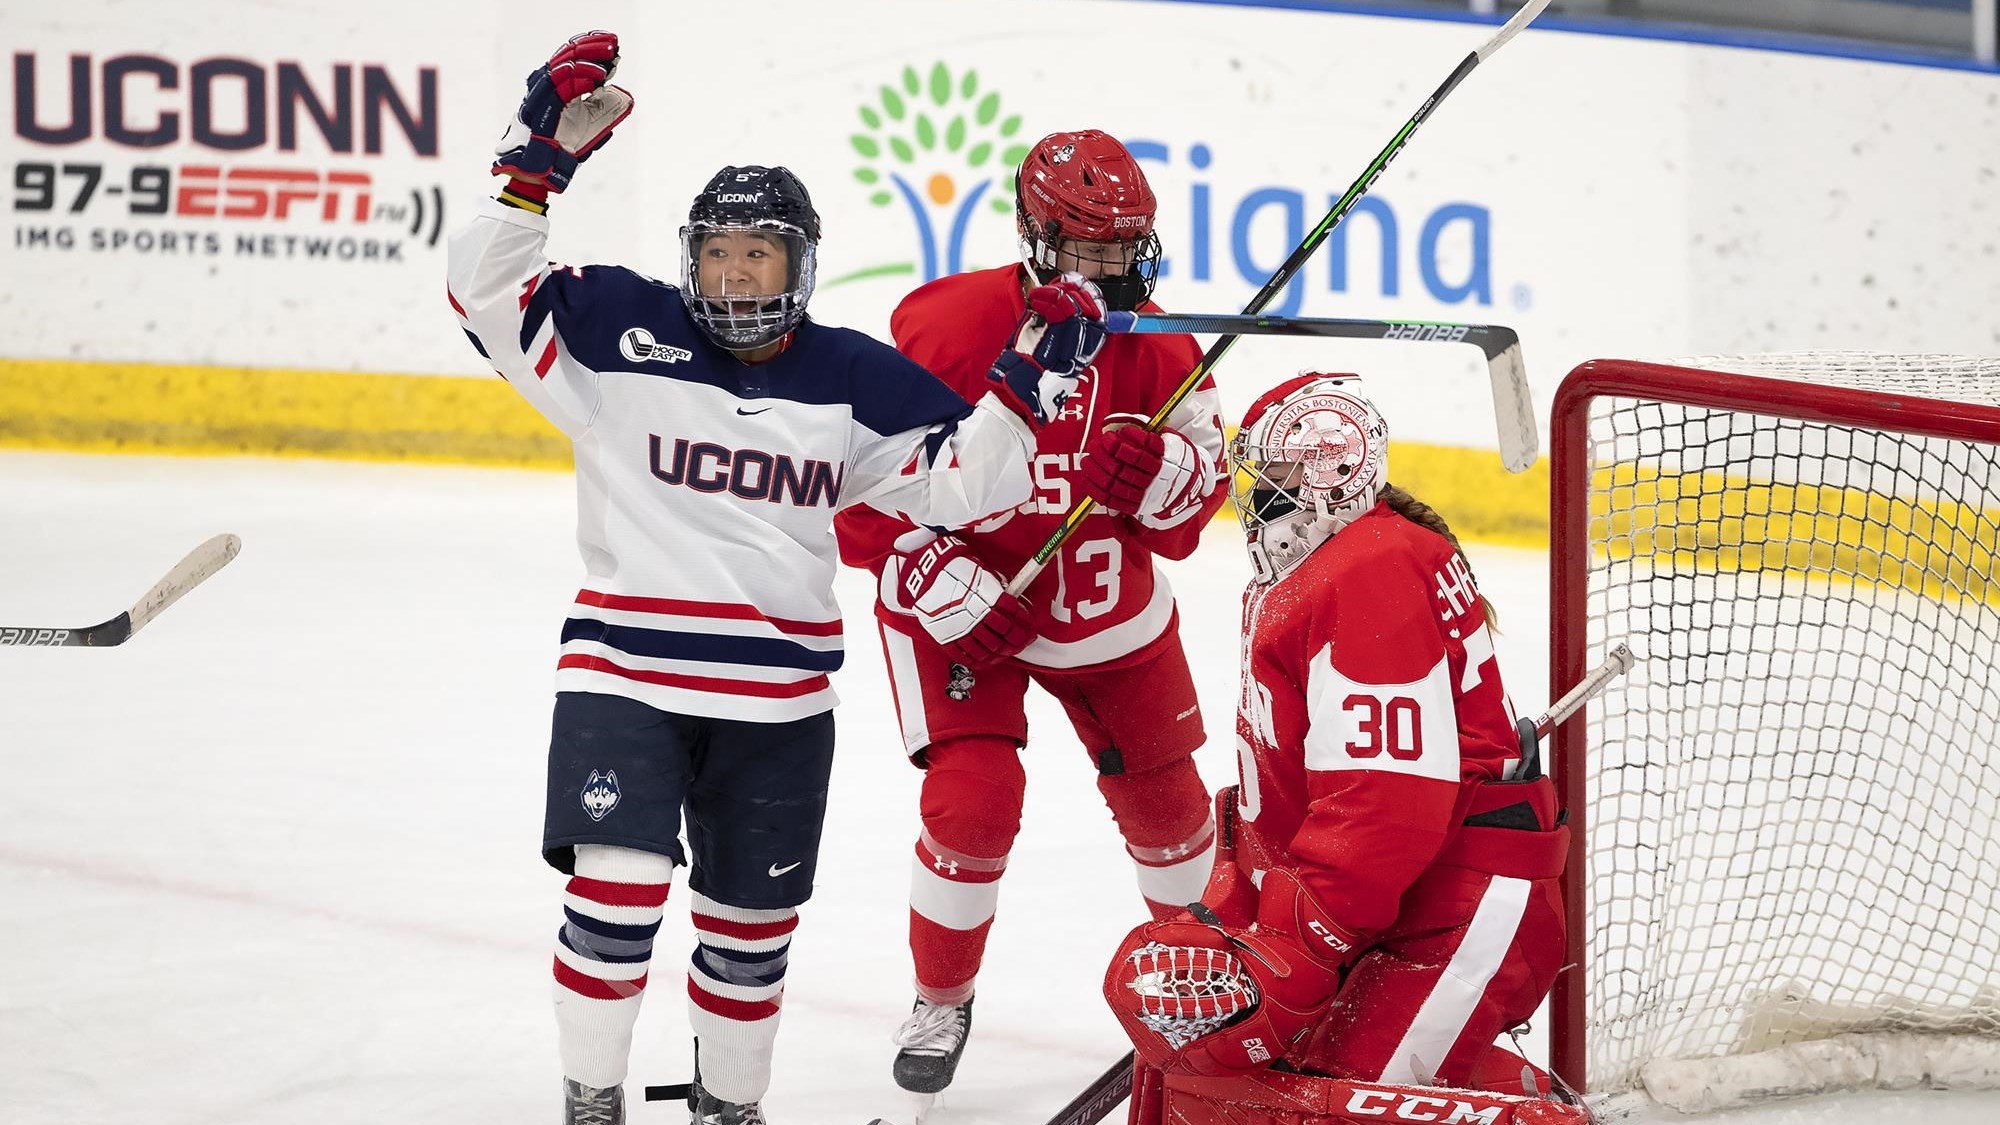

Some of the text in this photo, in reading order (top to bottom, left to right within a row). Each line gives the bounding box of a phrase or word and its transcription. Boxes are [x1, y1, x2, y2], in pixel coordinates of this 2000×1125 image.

[13, 52, 439, 158] UCONN
[716, 193, 759, 204] UCONN
[1113, 215, 1147, 228] BOSTON
[14, 229, 406, 262] IMG SPORTS NETWORK
[651, 351, 673, 361] EAST
[653, 346, 690, 359] HOCKEY
[648, 433, 845, 509] UCONN
[0, 629, 70, 647] AUER
[1342, 693, 1424, 762] 30
[1307, 920, 1352, 954] CCM
[1344, 1088, 1506, 1125] CCM
